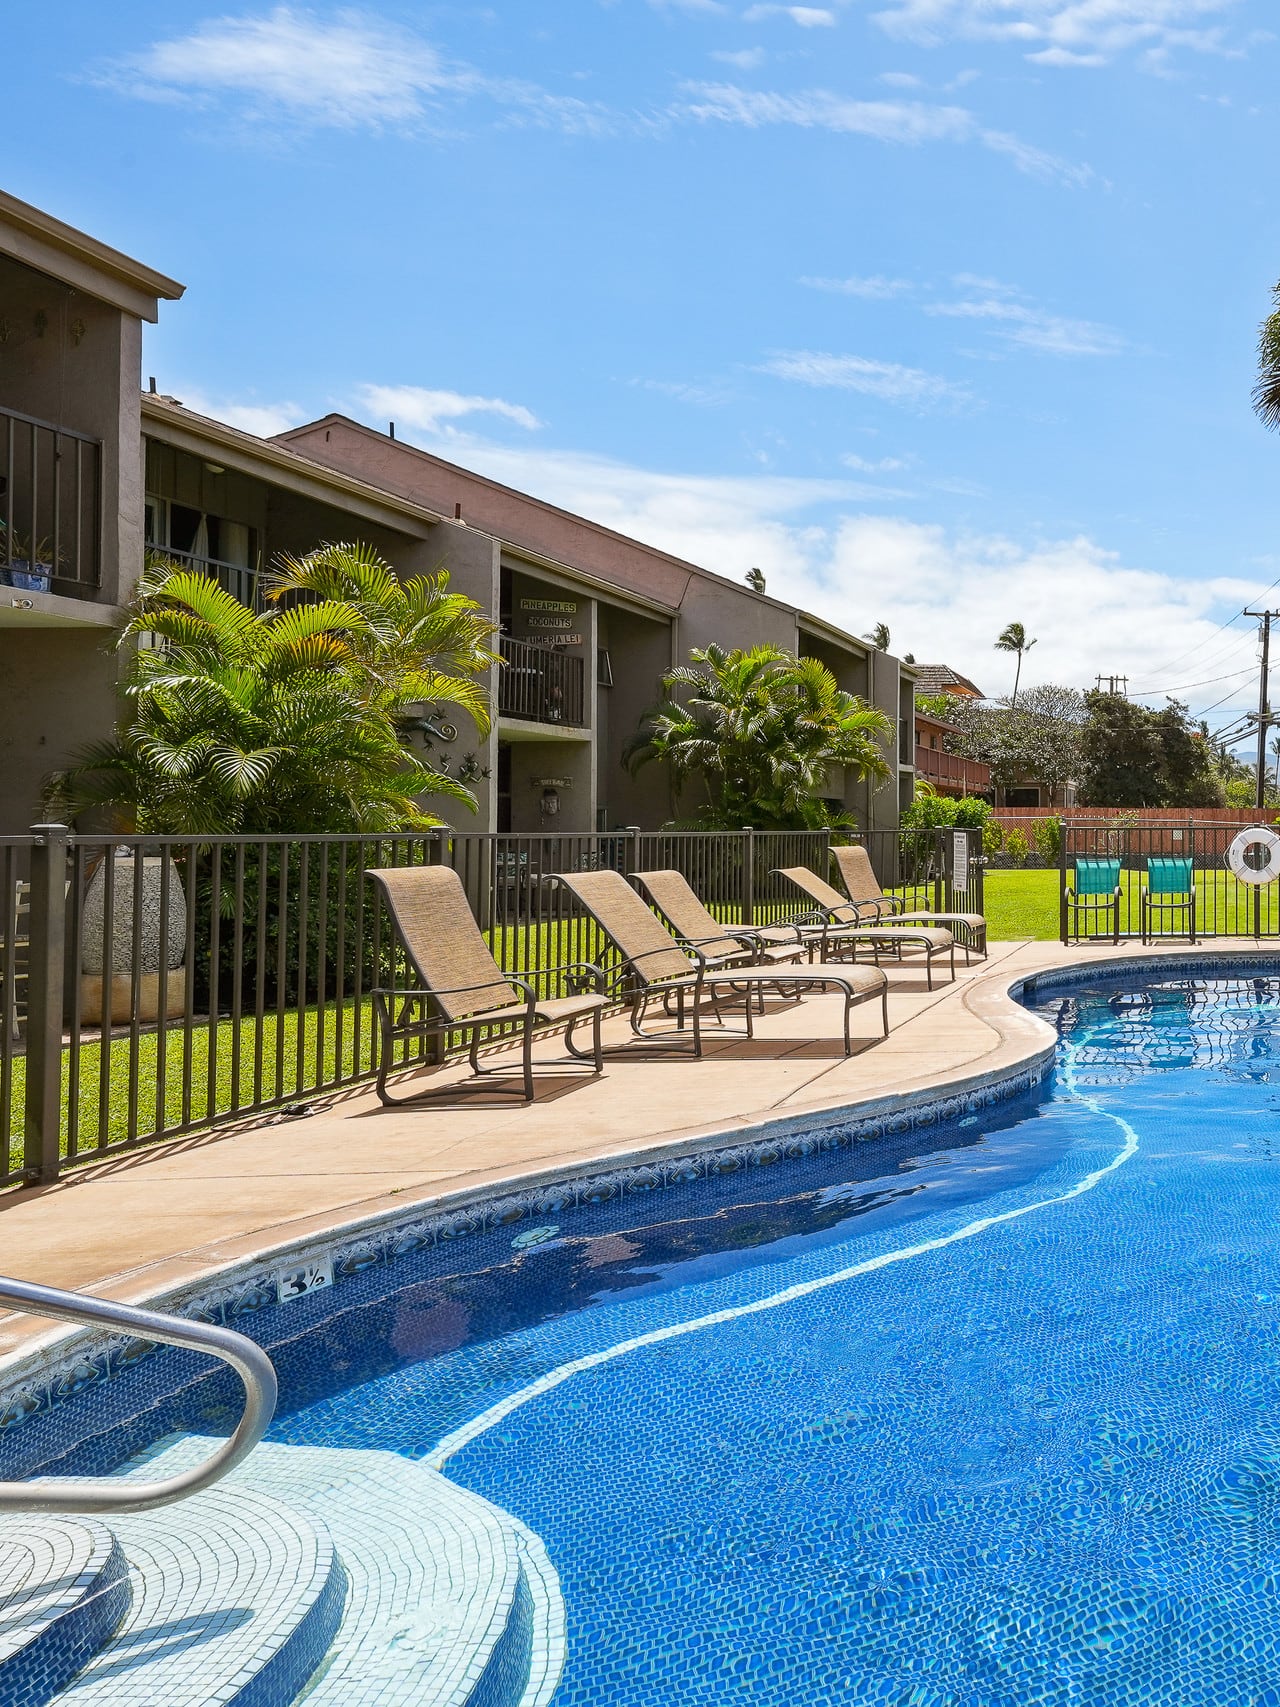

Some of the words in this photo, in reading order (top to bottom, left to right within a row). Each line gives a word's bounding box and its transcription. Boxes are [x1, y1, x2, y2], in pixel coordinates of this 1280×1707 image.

[522, 600, 576, 612] PINEAPPLES
[528, 617, 571, 627] COCONUTS
[521, 635, 562, 645] UMERIA
[565, 634, 579, 643] LEI
